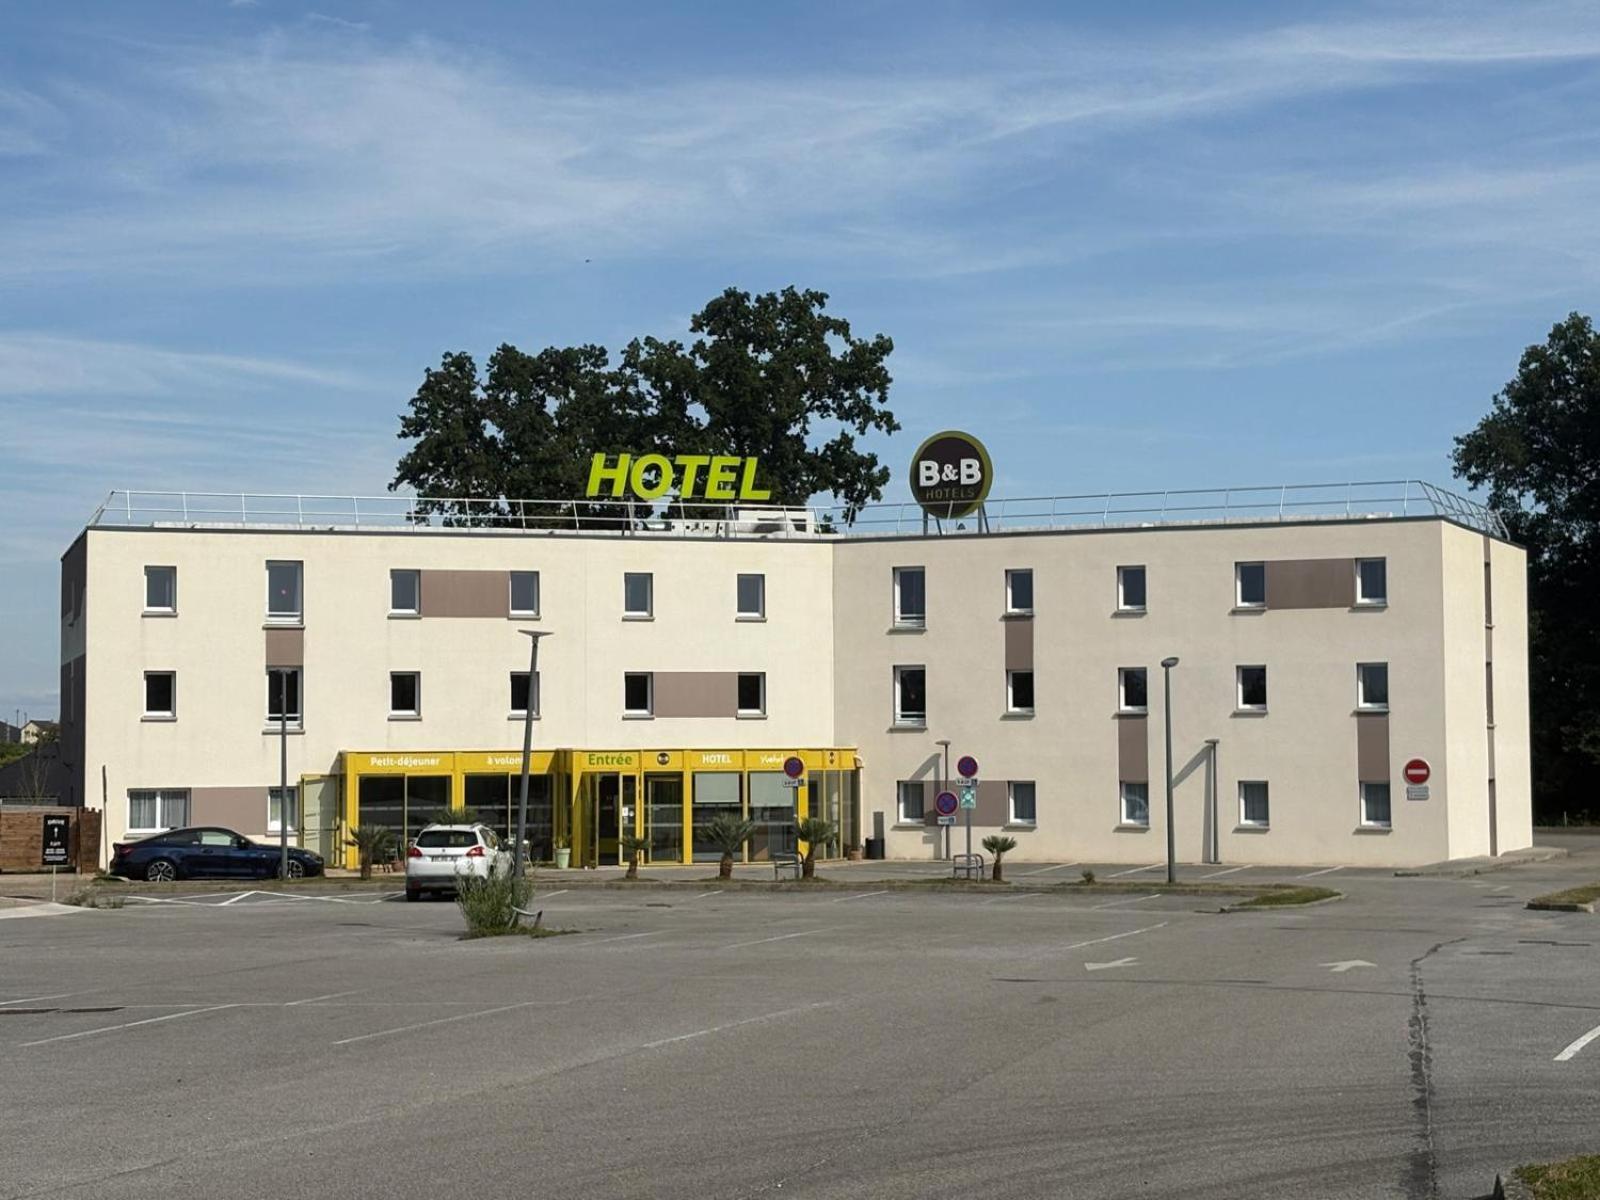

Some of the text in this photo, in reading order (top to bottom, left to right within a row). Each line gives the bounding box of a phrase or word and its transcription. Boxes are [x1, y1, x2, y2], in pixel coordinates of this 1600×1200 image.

[586, 452, 771, 500] HOTEL
[919, 458, 981, 487] B&B
[926, 487, 975, 499] HOTELS
[370, 756, 440, 767] Petit-déjeuner
[494, 756, 523, 765] volon
[588, 752, 632, 765] Entrée
[702, 754, 732, 764] HOTEL
